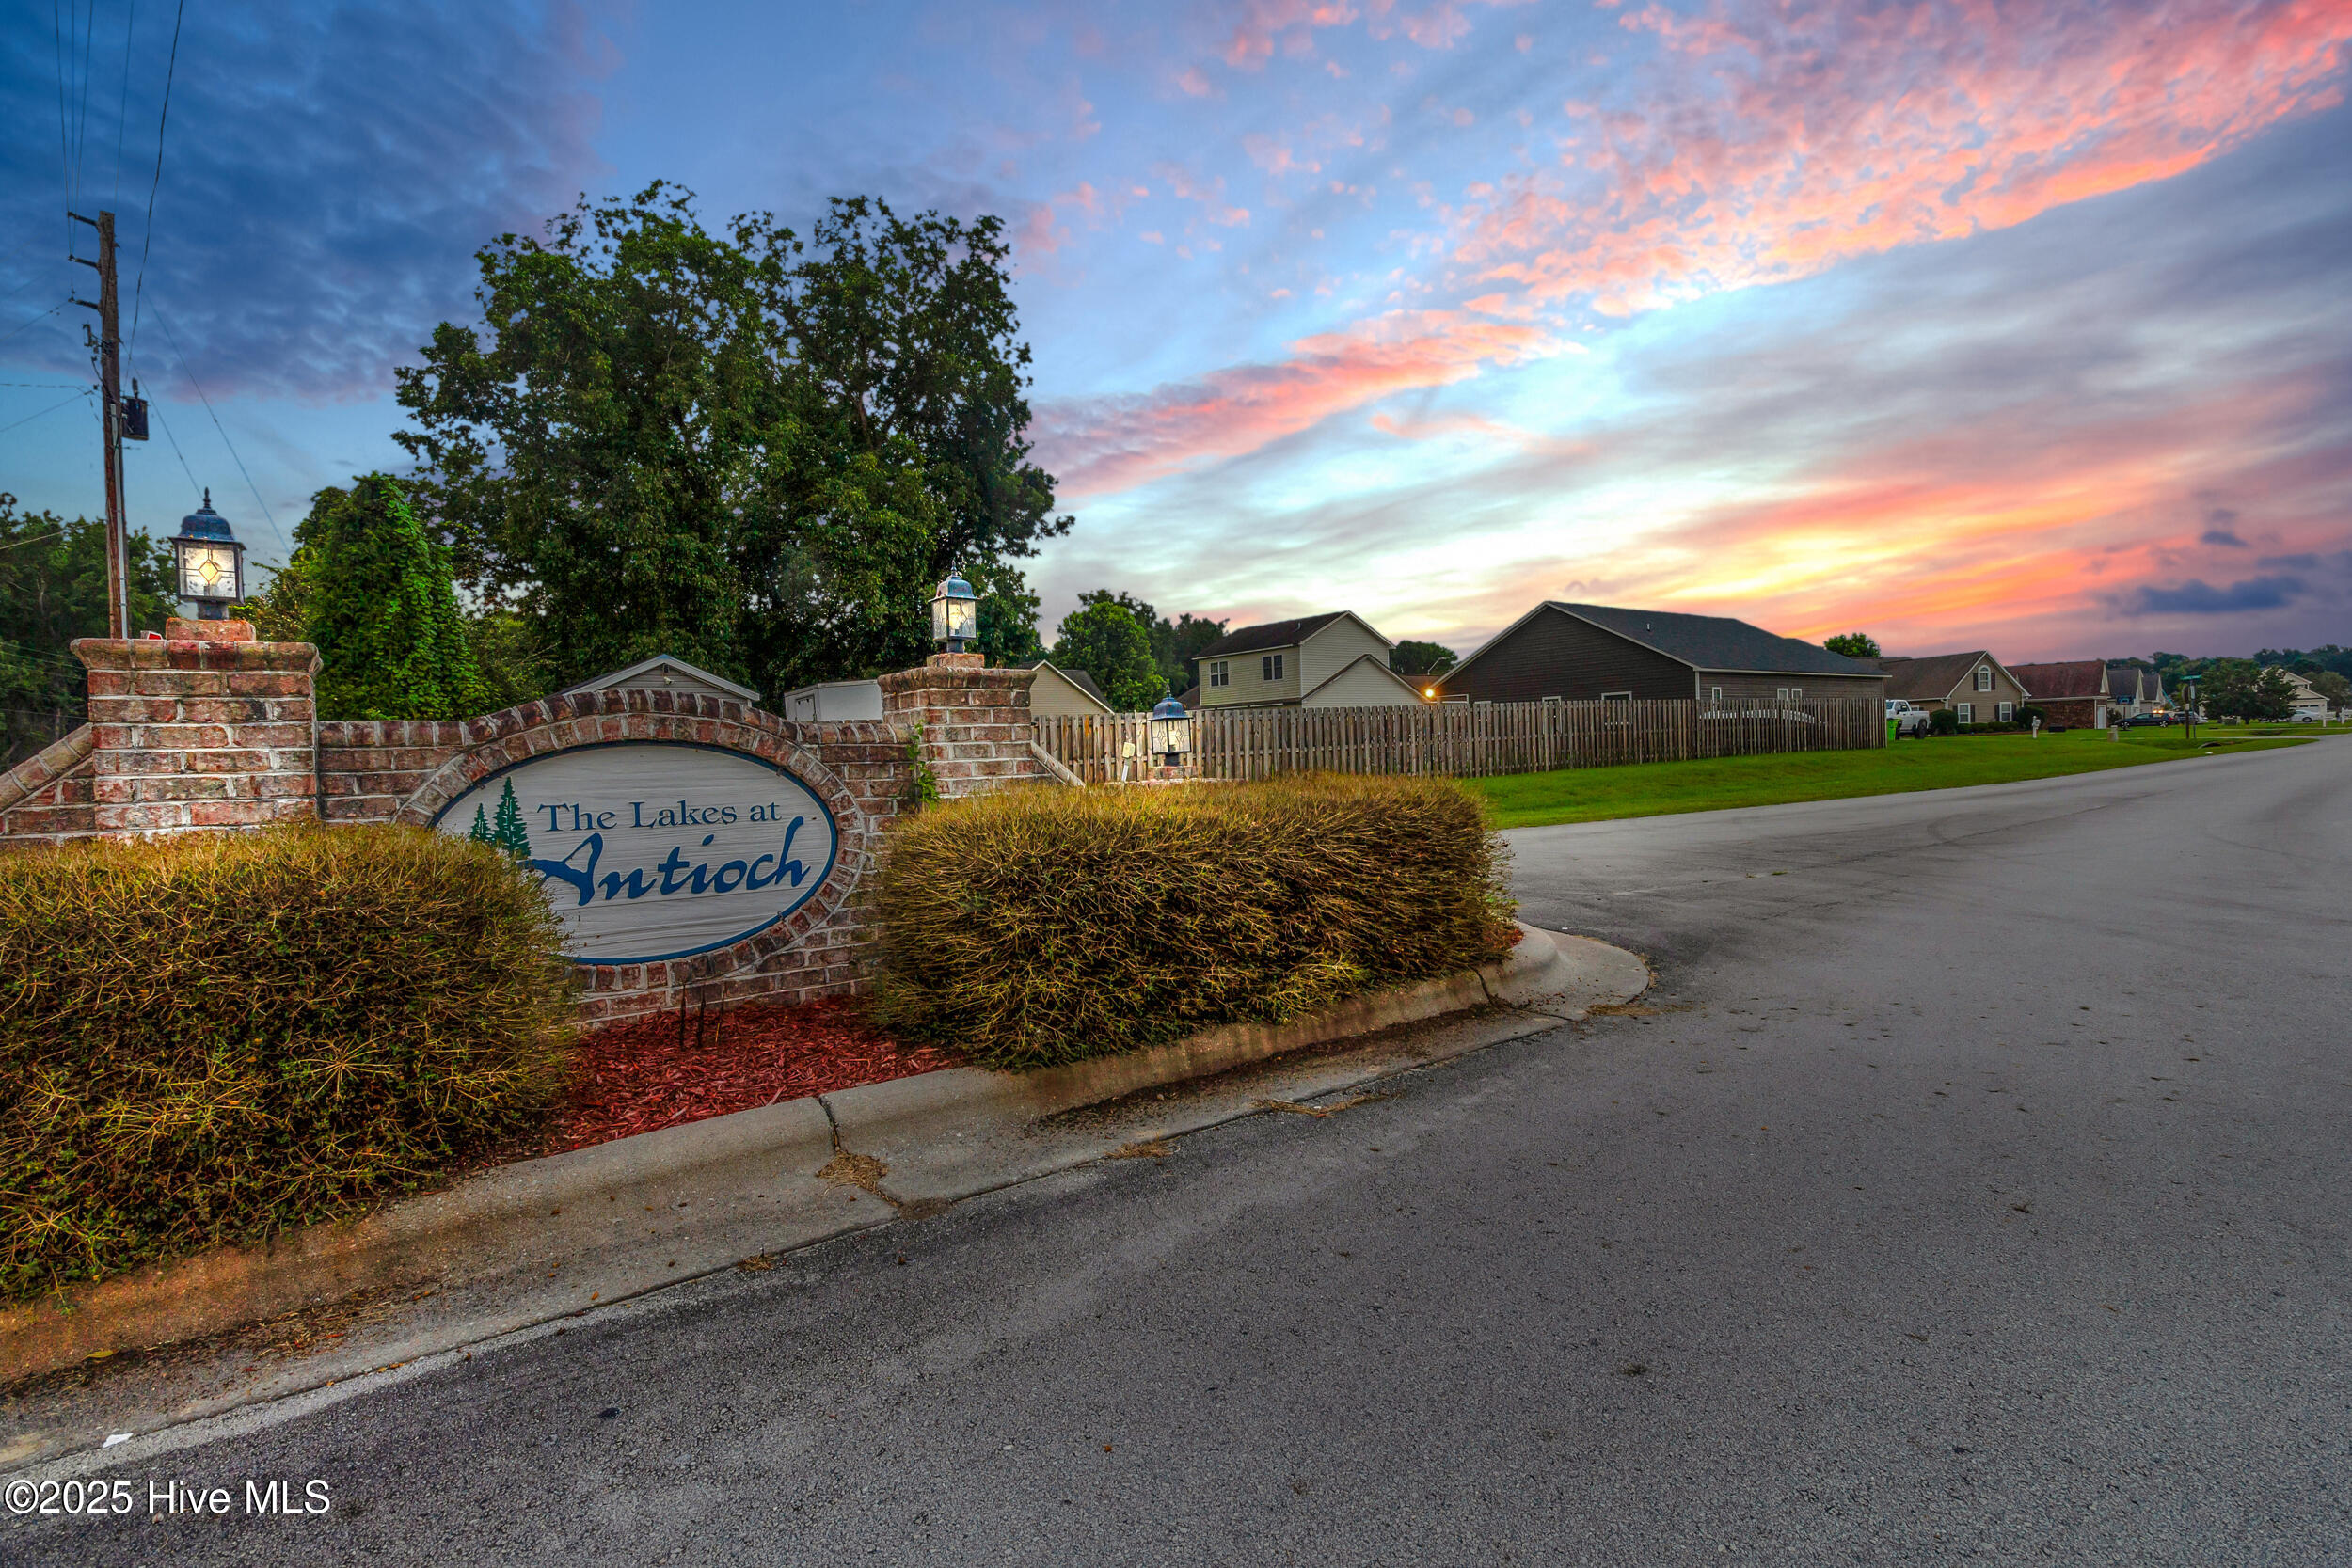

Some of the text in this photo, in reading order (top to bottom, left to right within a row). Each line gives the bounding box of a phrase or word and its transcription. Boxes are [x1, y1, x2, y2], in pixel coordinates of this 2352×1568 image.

[537, 799, 782, 832] The Lakes at
[518, 816, 812, 907] Antioch
